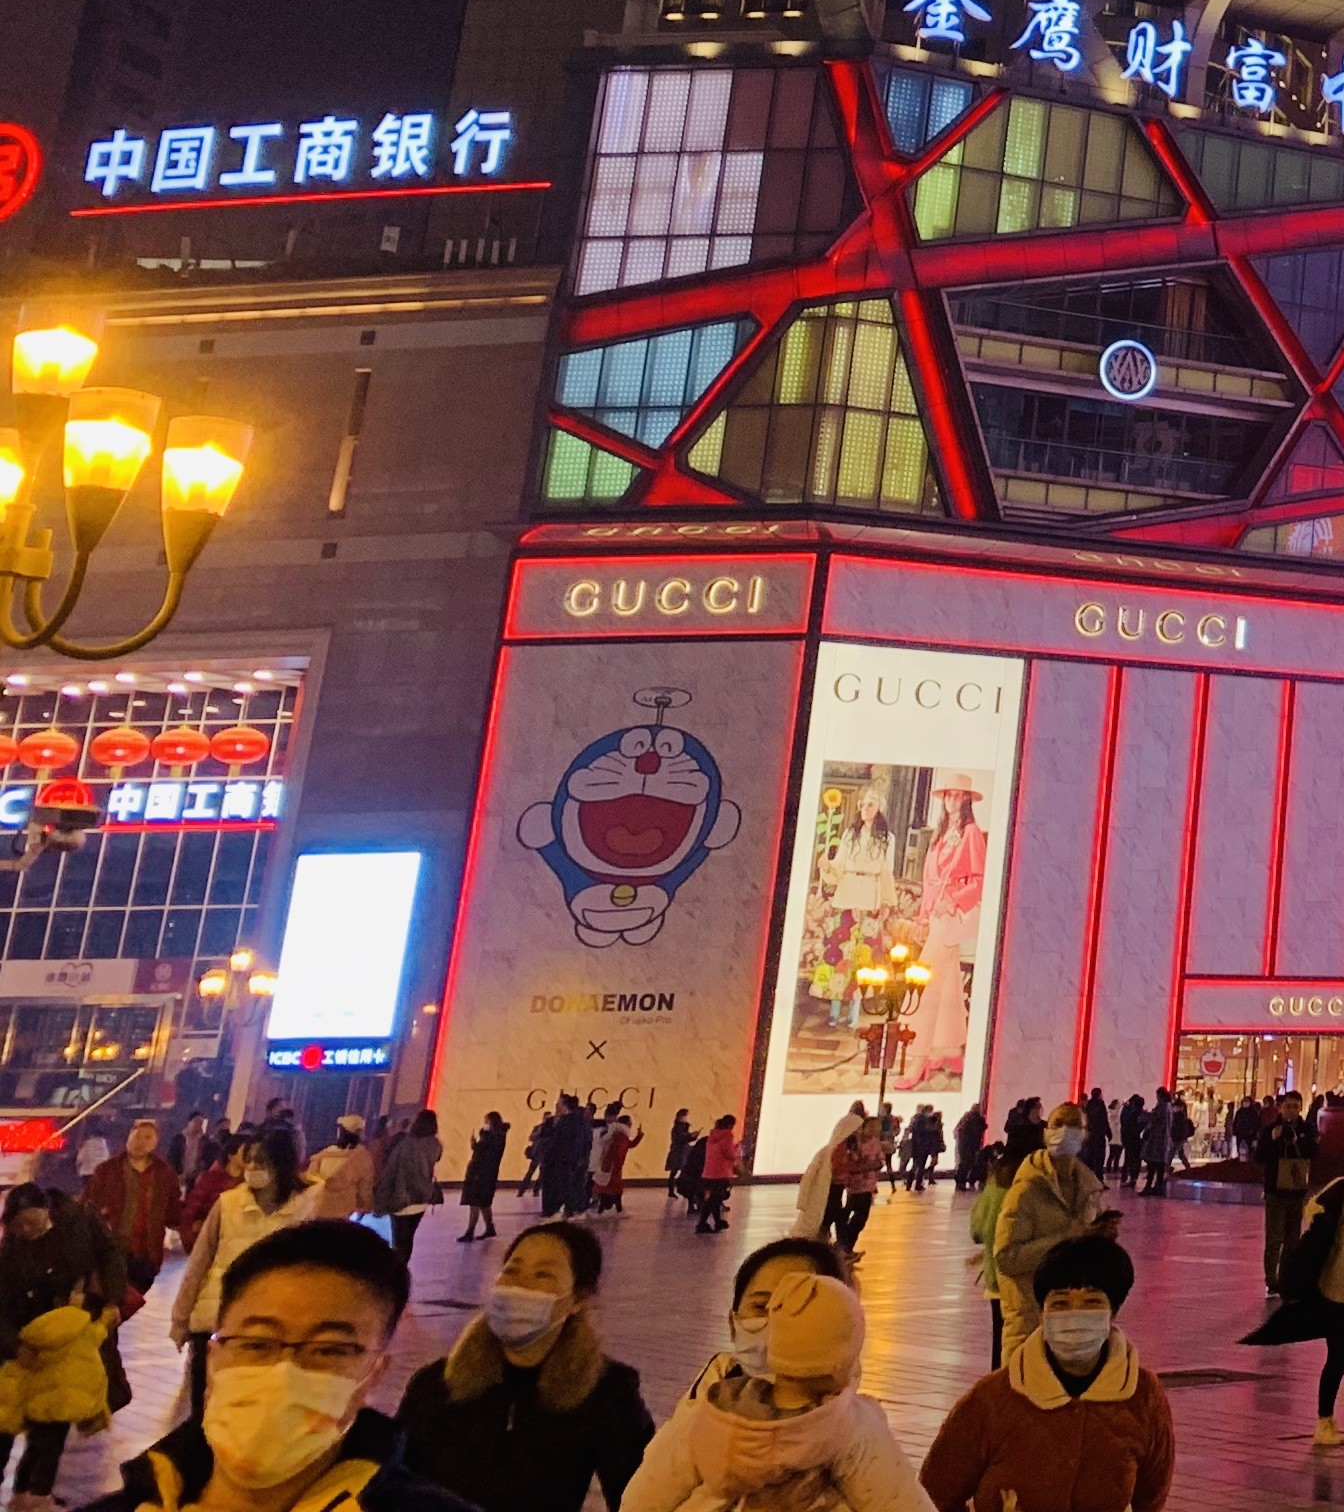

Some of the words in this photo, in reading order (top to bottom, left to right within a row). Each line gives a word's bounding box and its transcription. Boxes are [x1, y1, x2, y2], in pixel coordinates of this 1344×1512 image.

[85, 108, 511, 196] 中国工商银行
[565, 575, 764, 617] GUCCI
[1074, 601, 1248, 650] GUCCI
[833, 673, 1003, 715] GUCCI
